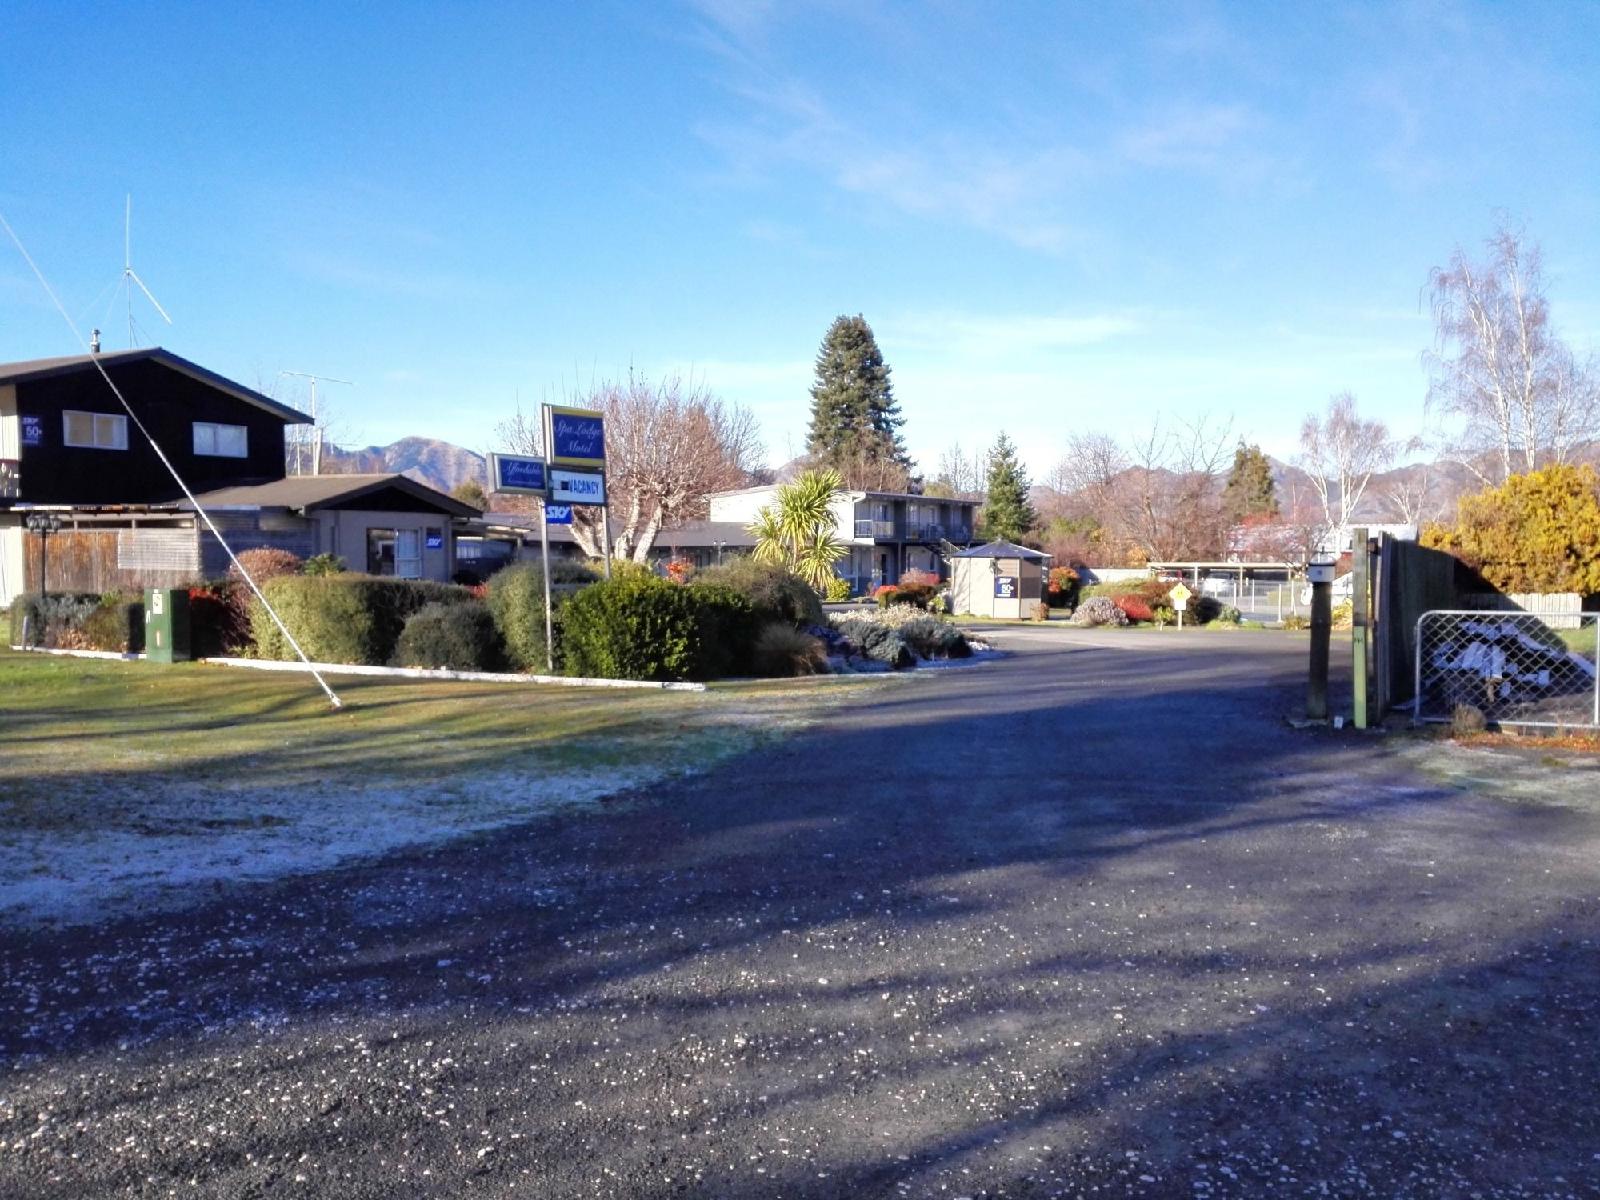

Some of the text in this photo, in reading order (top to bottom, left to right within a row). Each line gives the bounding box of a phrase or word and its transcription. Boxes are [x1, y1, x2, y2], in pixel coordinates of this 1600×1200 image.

[573, 423, 601, 440] Lodge
[567, 440, 593, 453] Motel
[569, 478, 599, 495] VACANCY
[546, 505, 571, 518] SKY
[426, 538, 441, 546] SKY
